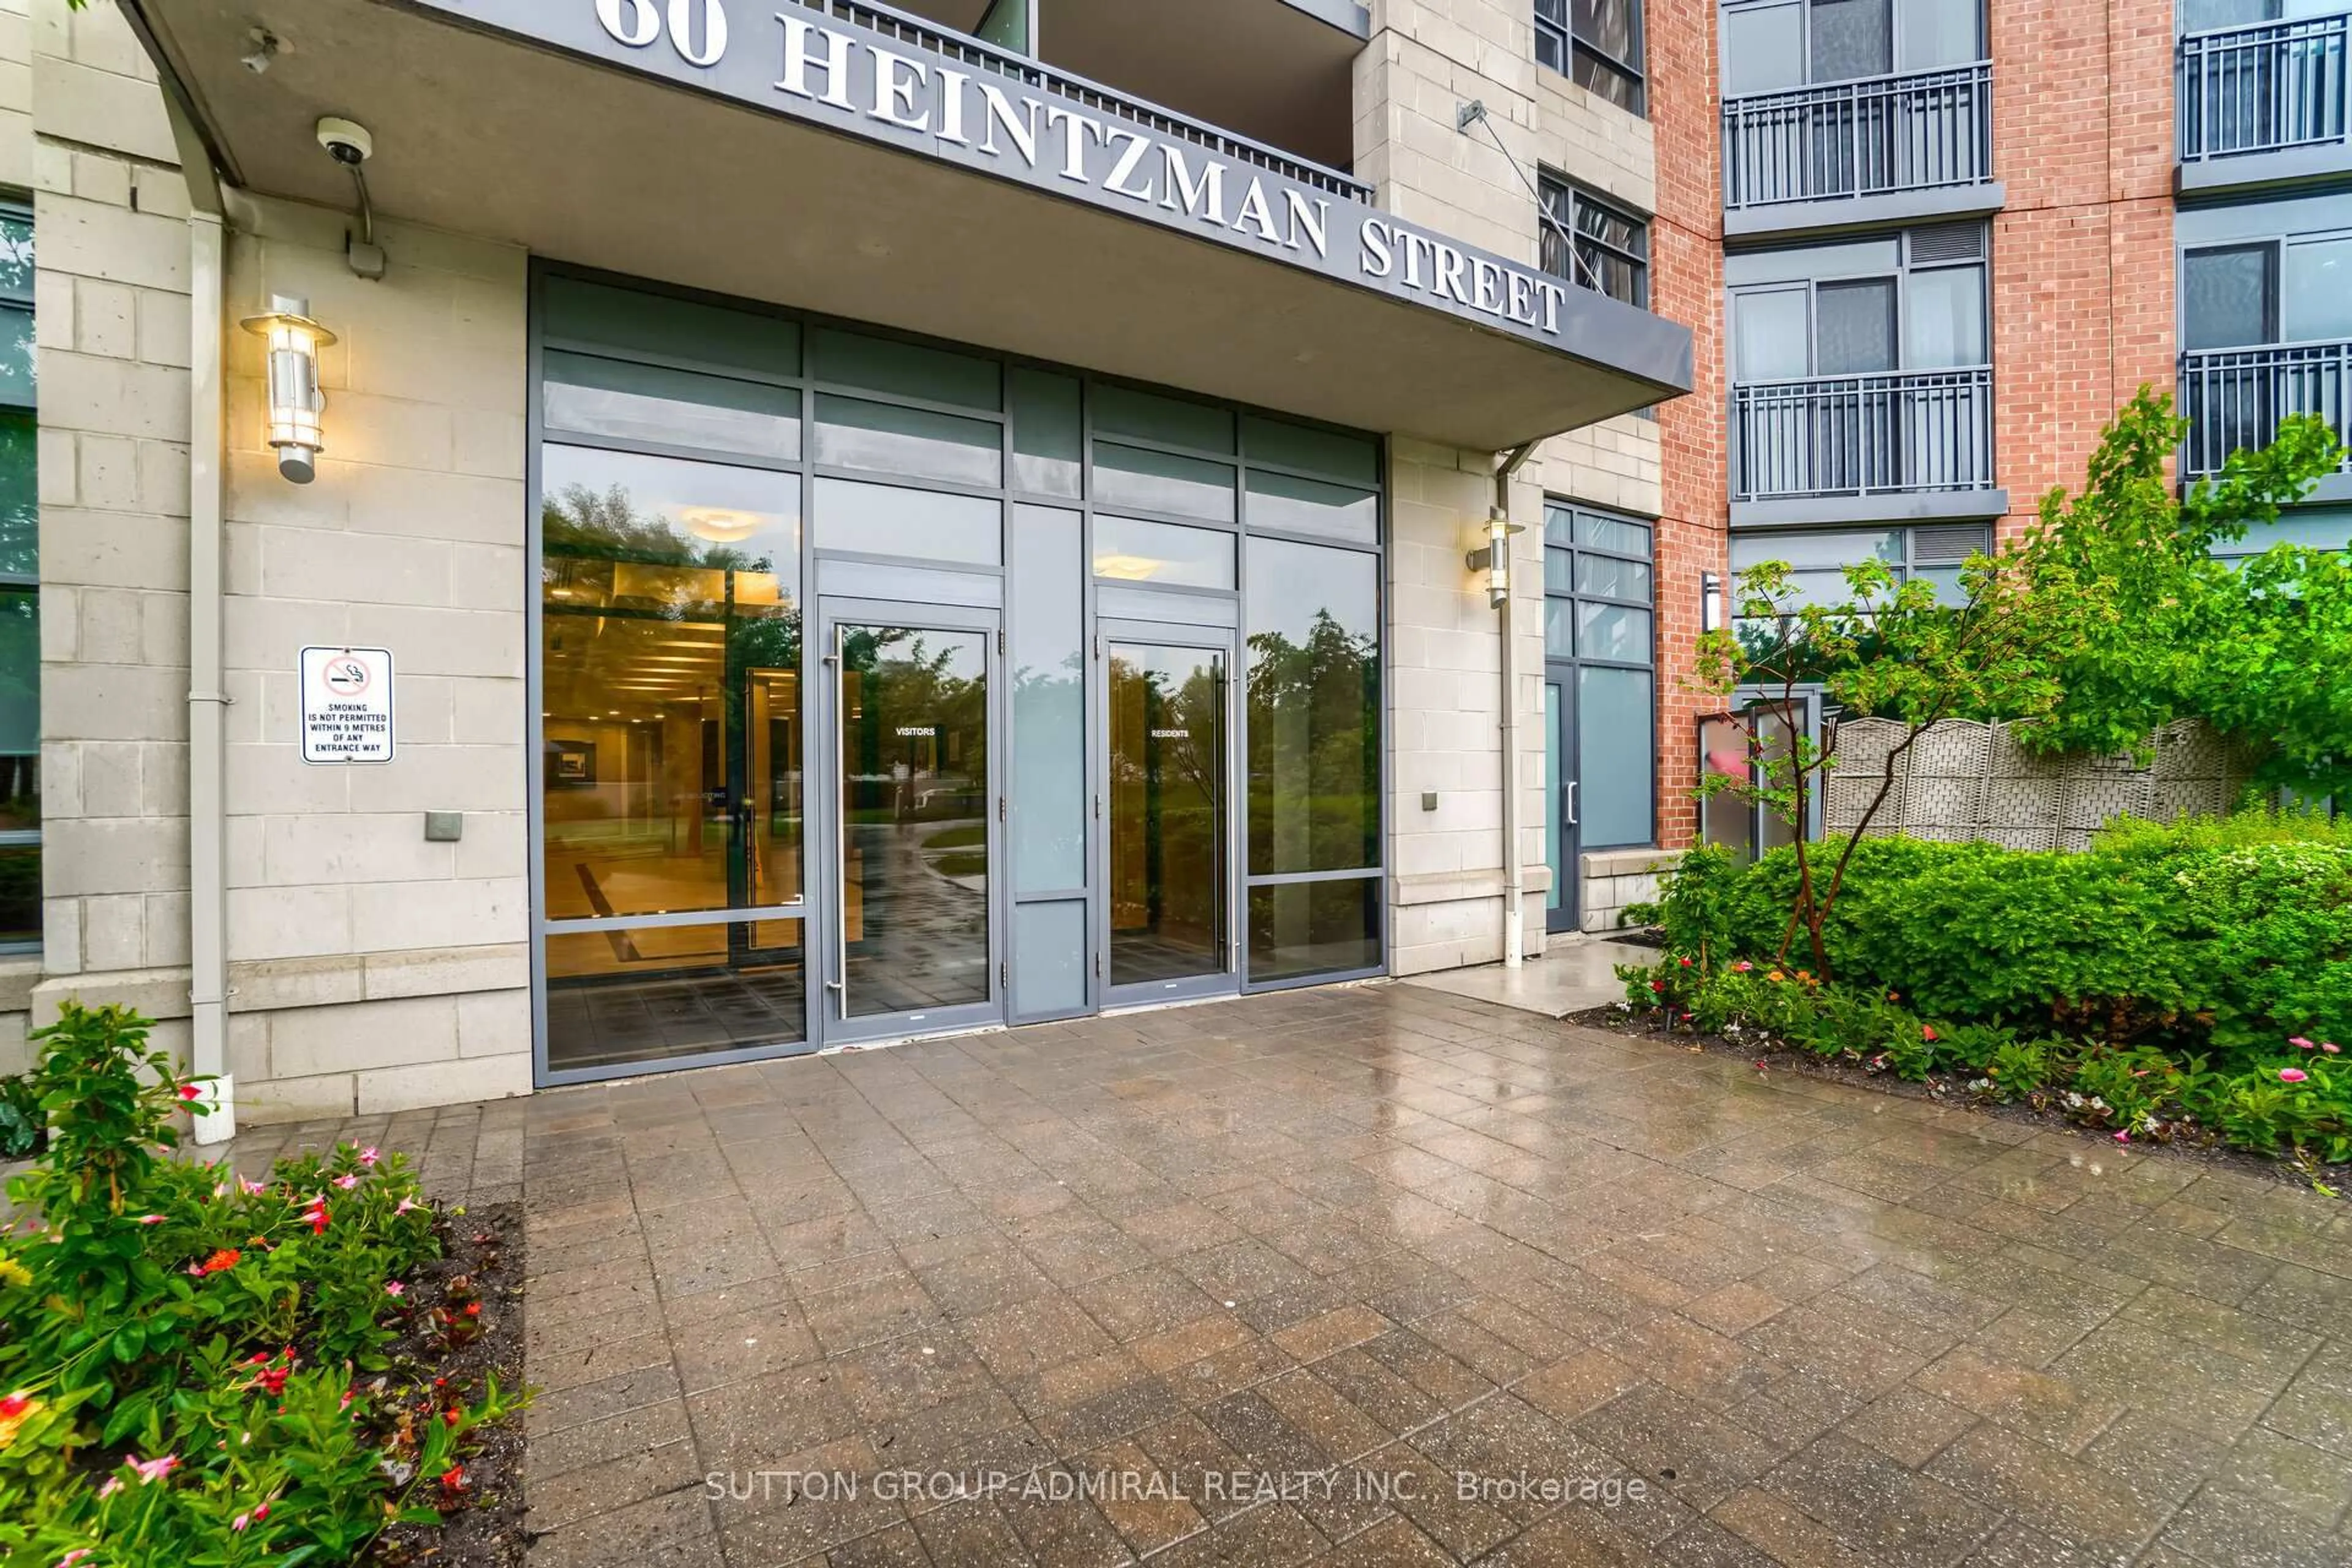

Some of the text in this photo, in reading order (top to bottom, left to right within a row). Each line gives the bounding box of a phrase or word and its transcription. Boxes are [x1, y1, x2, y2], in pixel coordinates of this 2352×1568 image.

[774, 12, 1329, 258] HEINTZMAN
[1360, 217, 1566, 334] STREET
[895, 727, 935, 736] VISITORS
